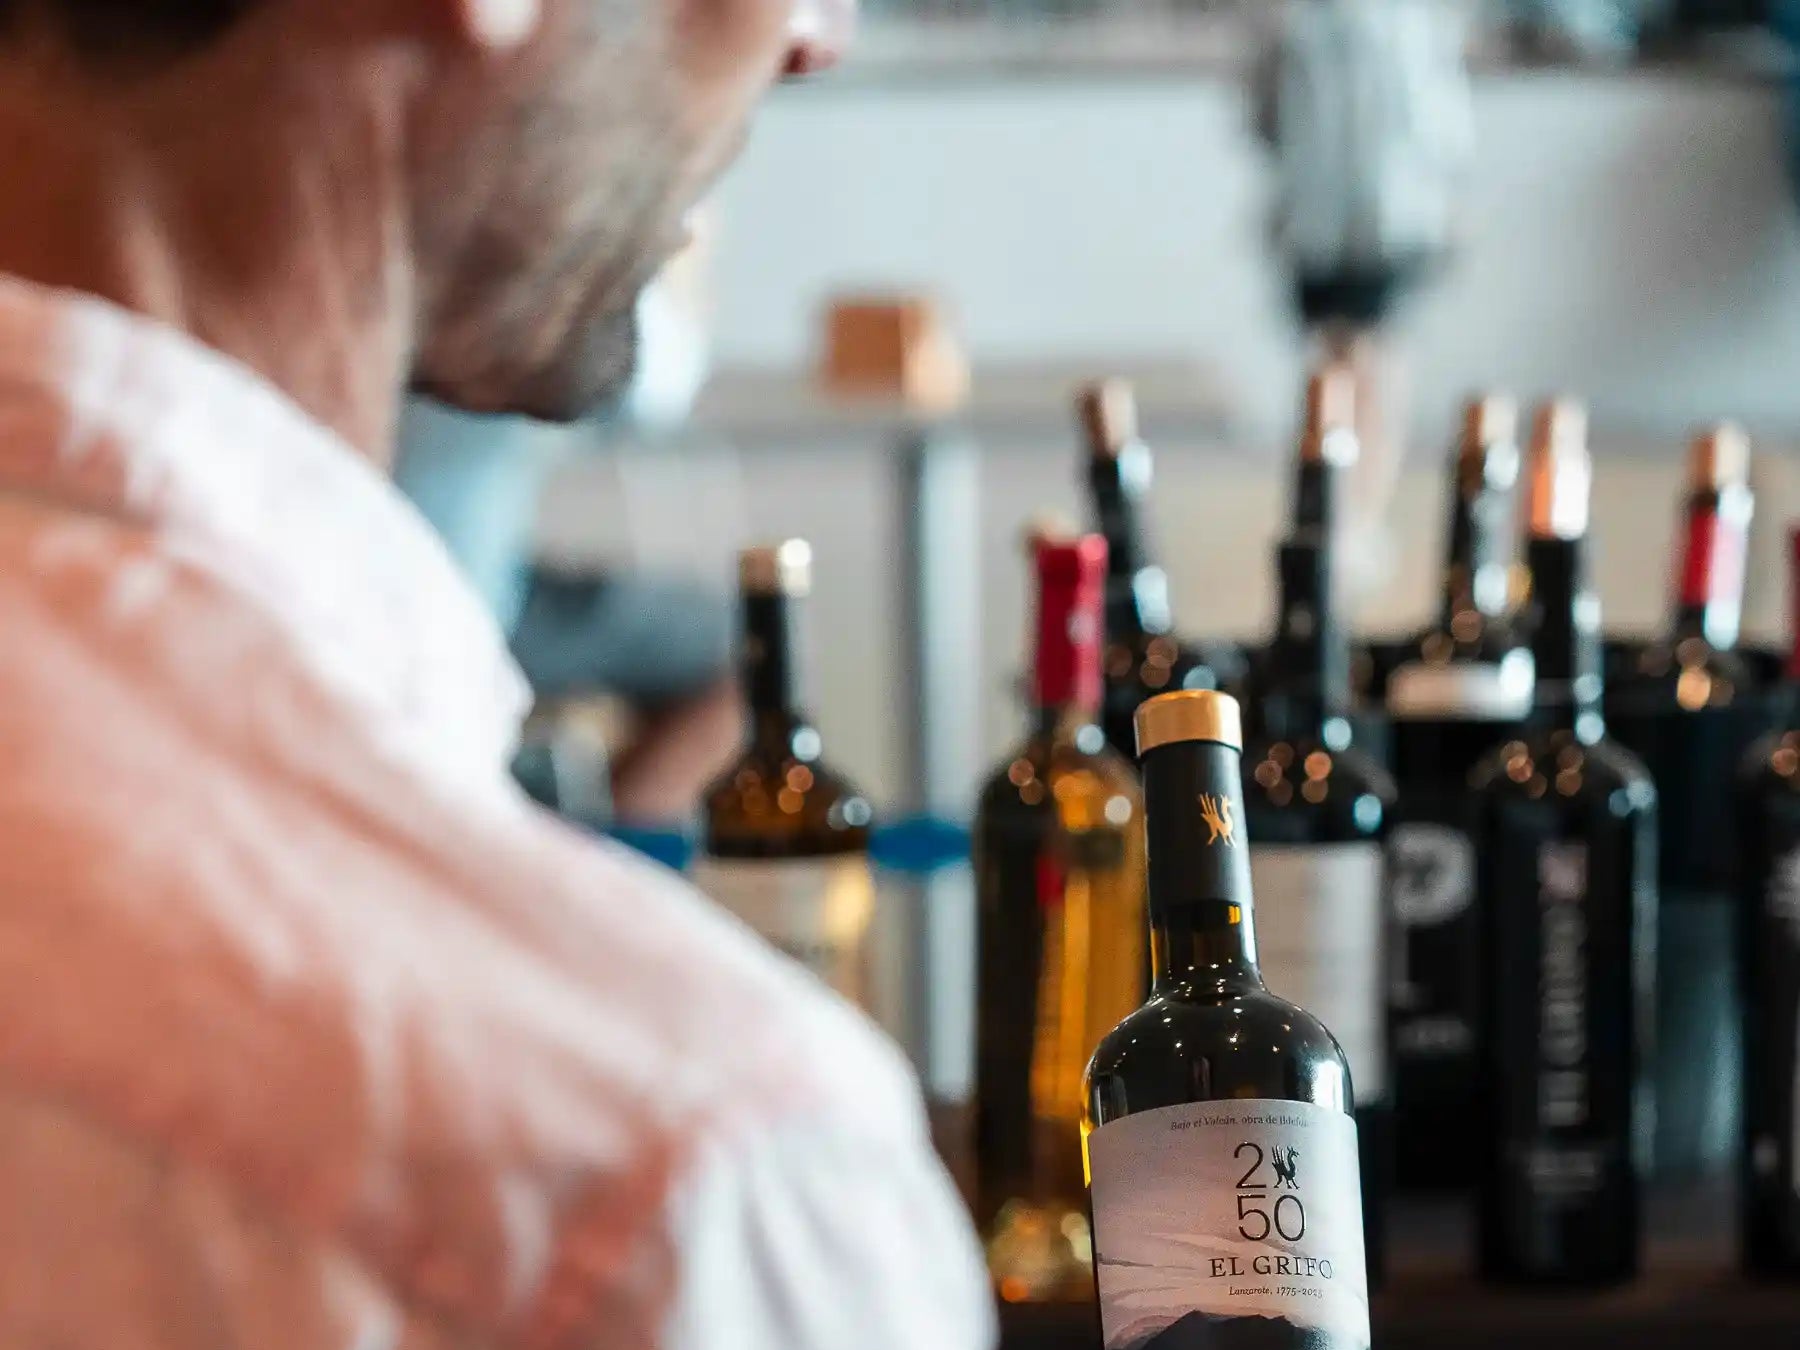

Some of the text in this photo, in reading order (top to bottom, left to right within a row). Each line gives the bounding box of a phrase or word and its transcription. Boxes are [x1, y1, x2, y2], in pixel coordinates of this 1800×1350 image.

[1241, 1115, 1263, 1124] obra
[1265, 1115, 1277, 1124] de
[1233, 1142, 1267, 1189] 2
[1236, 1194, 1307, 1242] 50
[1208, 1255, 1333, 1279] EL GRIFO
[1229, 1286, 1272, 1296] Lanzarote,
